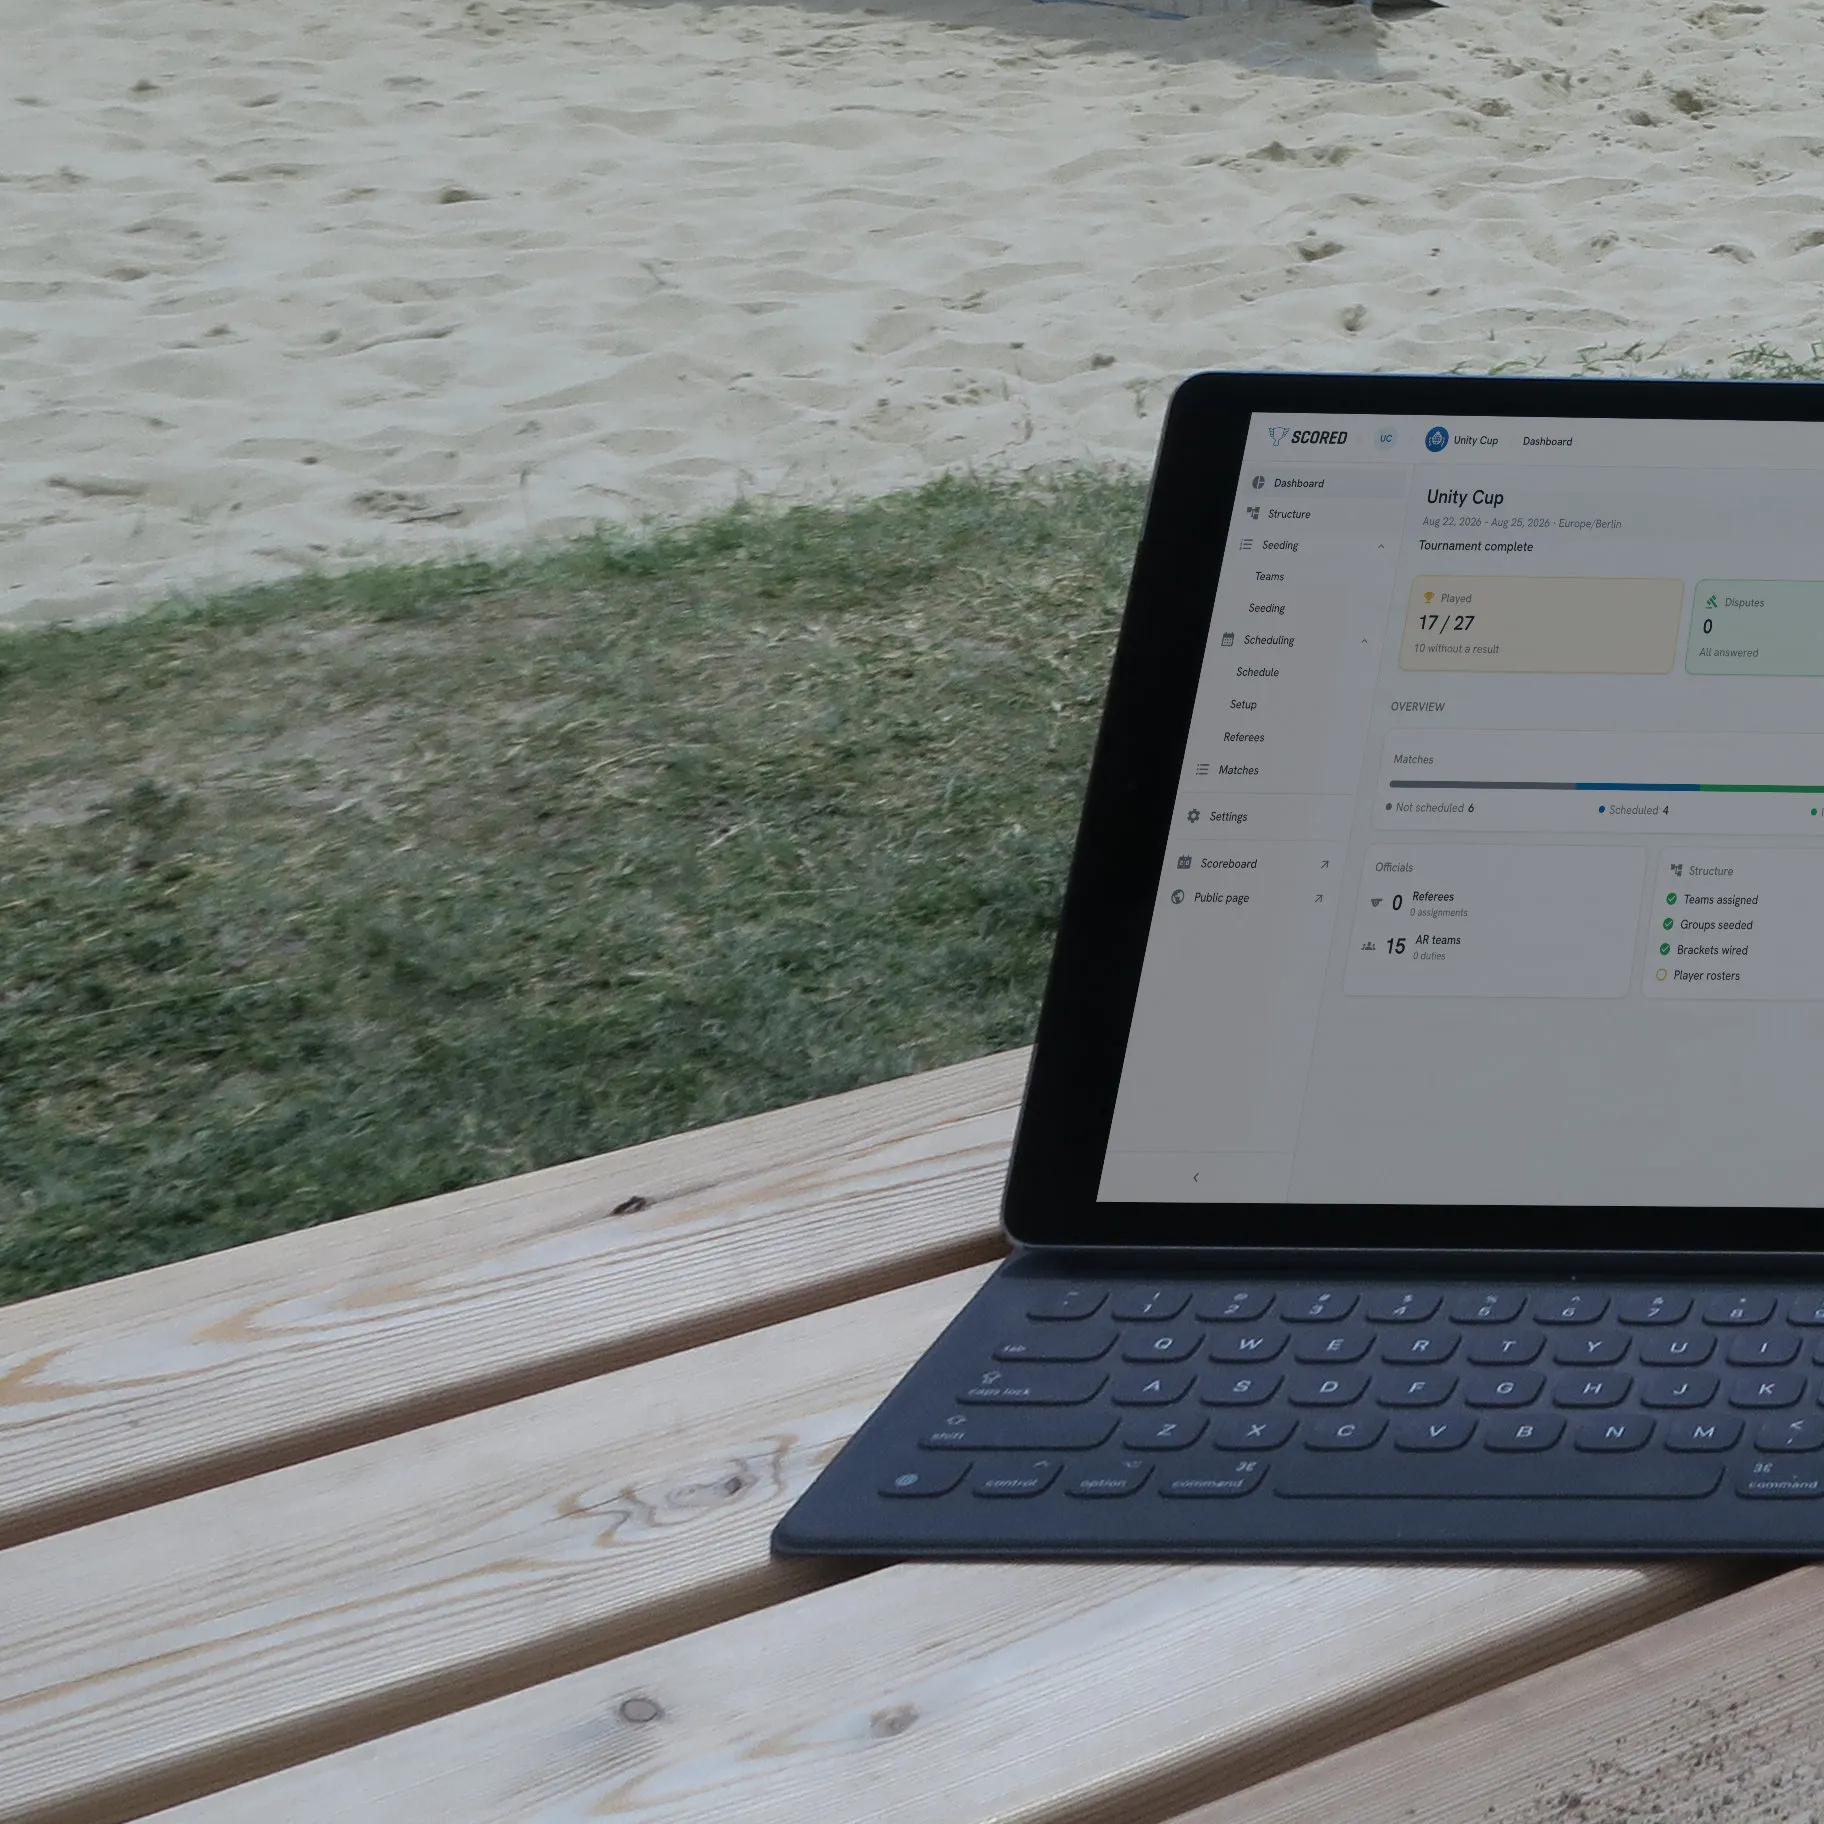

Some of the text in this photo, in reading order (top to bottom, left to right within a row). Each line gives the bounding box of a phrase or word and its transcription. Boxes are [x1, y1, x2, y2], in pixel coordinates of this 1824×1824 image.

[1290, 430, 1348, 445] SCORED
[1379, 433, 1393, 443] UC
[1453, 435, 1499, 448] Unity Cup
[1522, 435, 1574, 447] Dashboard
[1273, 477, 1325, 489] Dashboard
[1427, 488, 1505, 509] Unity Cup
[1267, 508, 1312, 520] Structure
[1422, 516, 1441, 529] Aug
[1441, 516, 1457, 527] 22,
[1458, 516, 1483, 527] 2026
[1490, 517, 1510, 530] Aug
[1510, 517, 1525, 529] 25,
[1527, 517, 1551, 528] 2026
[1558, 517, 1622, 531] Europe/Berlin
[1261, 539, 1299, 553] Seeding
[1419, 539, 1534, 555] Tournament complete
[1255, 570, 1285, 582] Teams
[1440, 592, 1473, 605] Played
[1724, 597, 1765, 610] Disputes
[1248, 602, 1286, 616] Seeding
[1419, 614, 1476, 635] 17 / 27
[1702, 618, 1713, 635] 0
[1243, 634, 1295, 648] Scheduling
[1414, 642, 1500, 655] 10 without a result
[1698, 647, 1760, 658] All answered
[1235, 666, 1280, 678] Schedule
[1229, 698, 1258, 712] Setup
[1390, 700, 1446, 712] OVERVIEW
[1223, 731, 1265, 743] Referees
[1393, 753, 1434, 765] Matches
[1218, 764, 1259, 776] Matches
[1395, 802, 1475, 814] Not scheduled 6
[1608, 804, 1670, 816] Scheduled 4
[1209, 810, 1248, 825] Settings
[1200, 857, 1258, 869] Scoreboard
[1375, 861, 1414, 873] Officials
[1688, 865, 1734, 877] Structure
[1193, 891, 1250, 906] Public page
[1392, 893, 1403, 911] 0
[1412, 890, 1455, 902] Referees
[1683, 893, 1760, 908] Teams assigned
[1409, 907, 1469, 920] 0 assignments
[1679, 918, 1754, 933] Groups seeded
[1386, 937, 1407, 955] 15
[1415, 934, 1462, 945] AR teams
[1412, 950, 1446, 961] 0 duties
[1676, 943, 1749, 956] Brackets wired
[1673, 969, 1741, 983] Player rosters
[1153, 1336, 1174, 1351] Q
[1238, 1337, 1265, 1351] W
[1325, 1337, 1345, 1352] E
[1411, 1338, 1431, 1352] R
[1501, 1339, 1518, 1353] T
[1586, 1339, 1603, 1354] Y
[1669, 1341, 1689, 1354] U
[1142, 1379, 1162, 1393] A
[1231, 1378, 1253, 1394] S
[1318, 1379, 1340, 1394] D
[1407, 1380, 1427, 1394] F
[1495, 1380, 1515, 1395] G
[1582, 1381, 1604, 1395] H
[1757, 1382, 1776, 1396] K
[1155, 1422, 1178, 1437] Z
[1245, 1423, 1268, 1438] X
[1335, 1423, 1357, 1438] C
[1428, 1424, 1448, 1438] V
[1515, 1424, 1535, 1439] B
[1604, 1425, 1626, 1439] N
[1692, 1425, 1716, 1439] M
